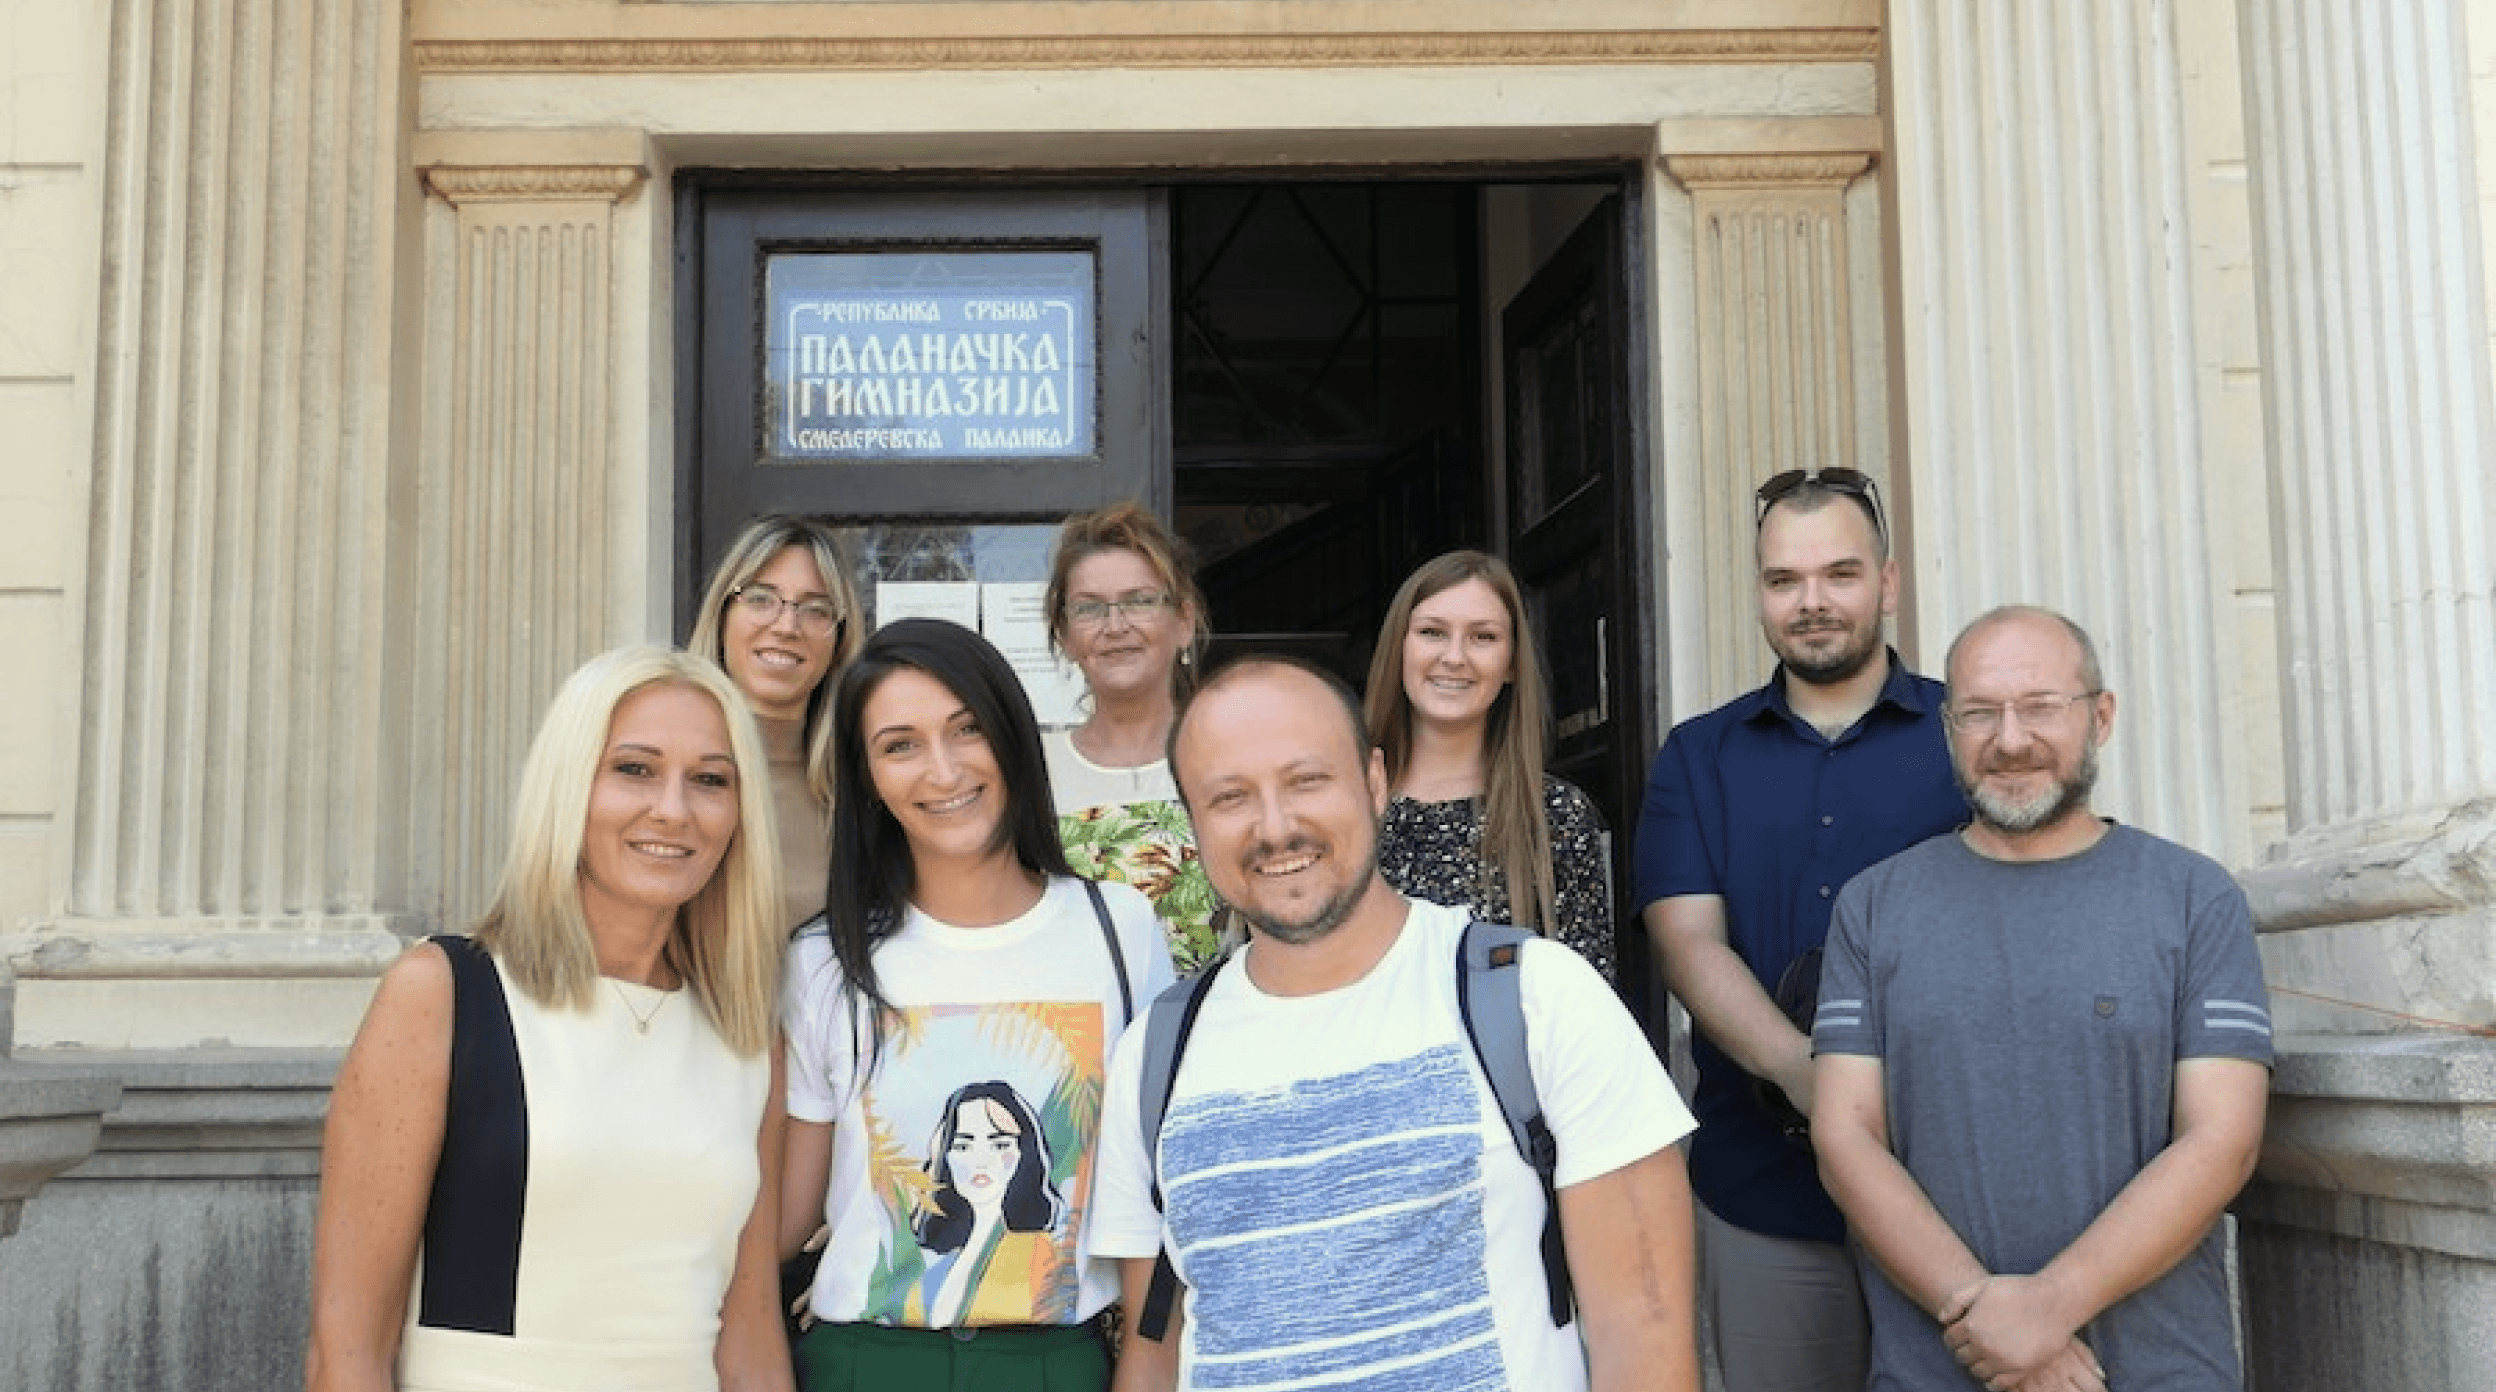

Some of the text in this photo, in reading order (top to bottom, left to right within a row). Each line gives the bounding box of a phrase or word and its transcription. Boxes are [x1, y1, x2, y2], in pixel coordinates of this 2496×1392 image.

[963, 300, 1039, 322] СРБИЈА
[801, 332, 1061, 374] ПАЛАНАЧКА
[800, 376, 1061, 418] ГИМНАЗИЈА
[964, 427, 1063, 450] ПАЛАНКА
